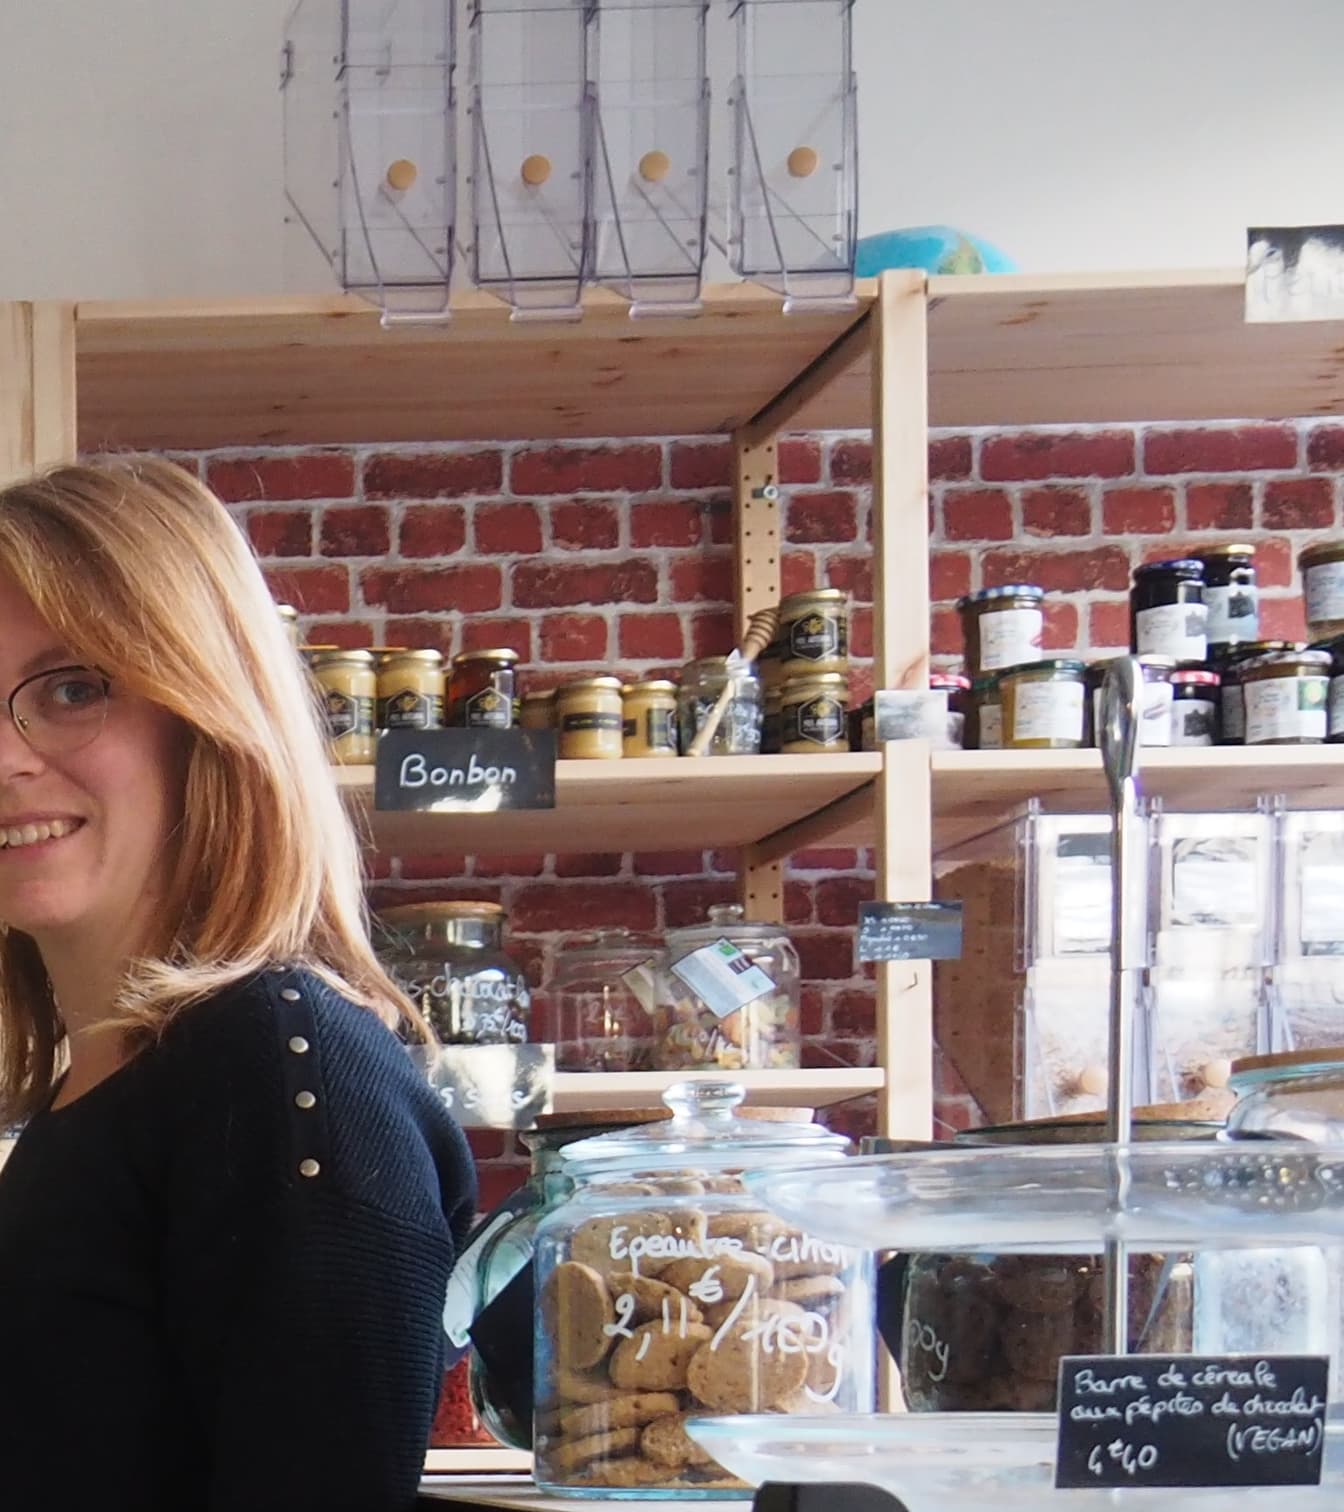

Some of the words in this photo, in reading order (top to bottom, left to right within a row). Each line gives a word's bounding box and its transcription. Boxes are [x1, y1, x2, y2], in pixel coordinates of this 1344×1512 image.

[400, 753, 517, 787] Bonbon
[1075, 1368, 1147, 1395] Barre
[1157, 1363, 1188, 1387] de
[1070, 1406, 1121, 1423] aux
[1125, 1391, 1204, 1425] pépites
[1211, 1392, 1240, 1414] de
[1243, 1386, 1326, 1415] chocolat
[1227, 1418, 1324, 1462] (VEGAN)
